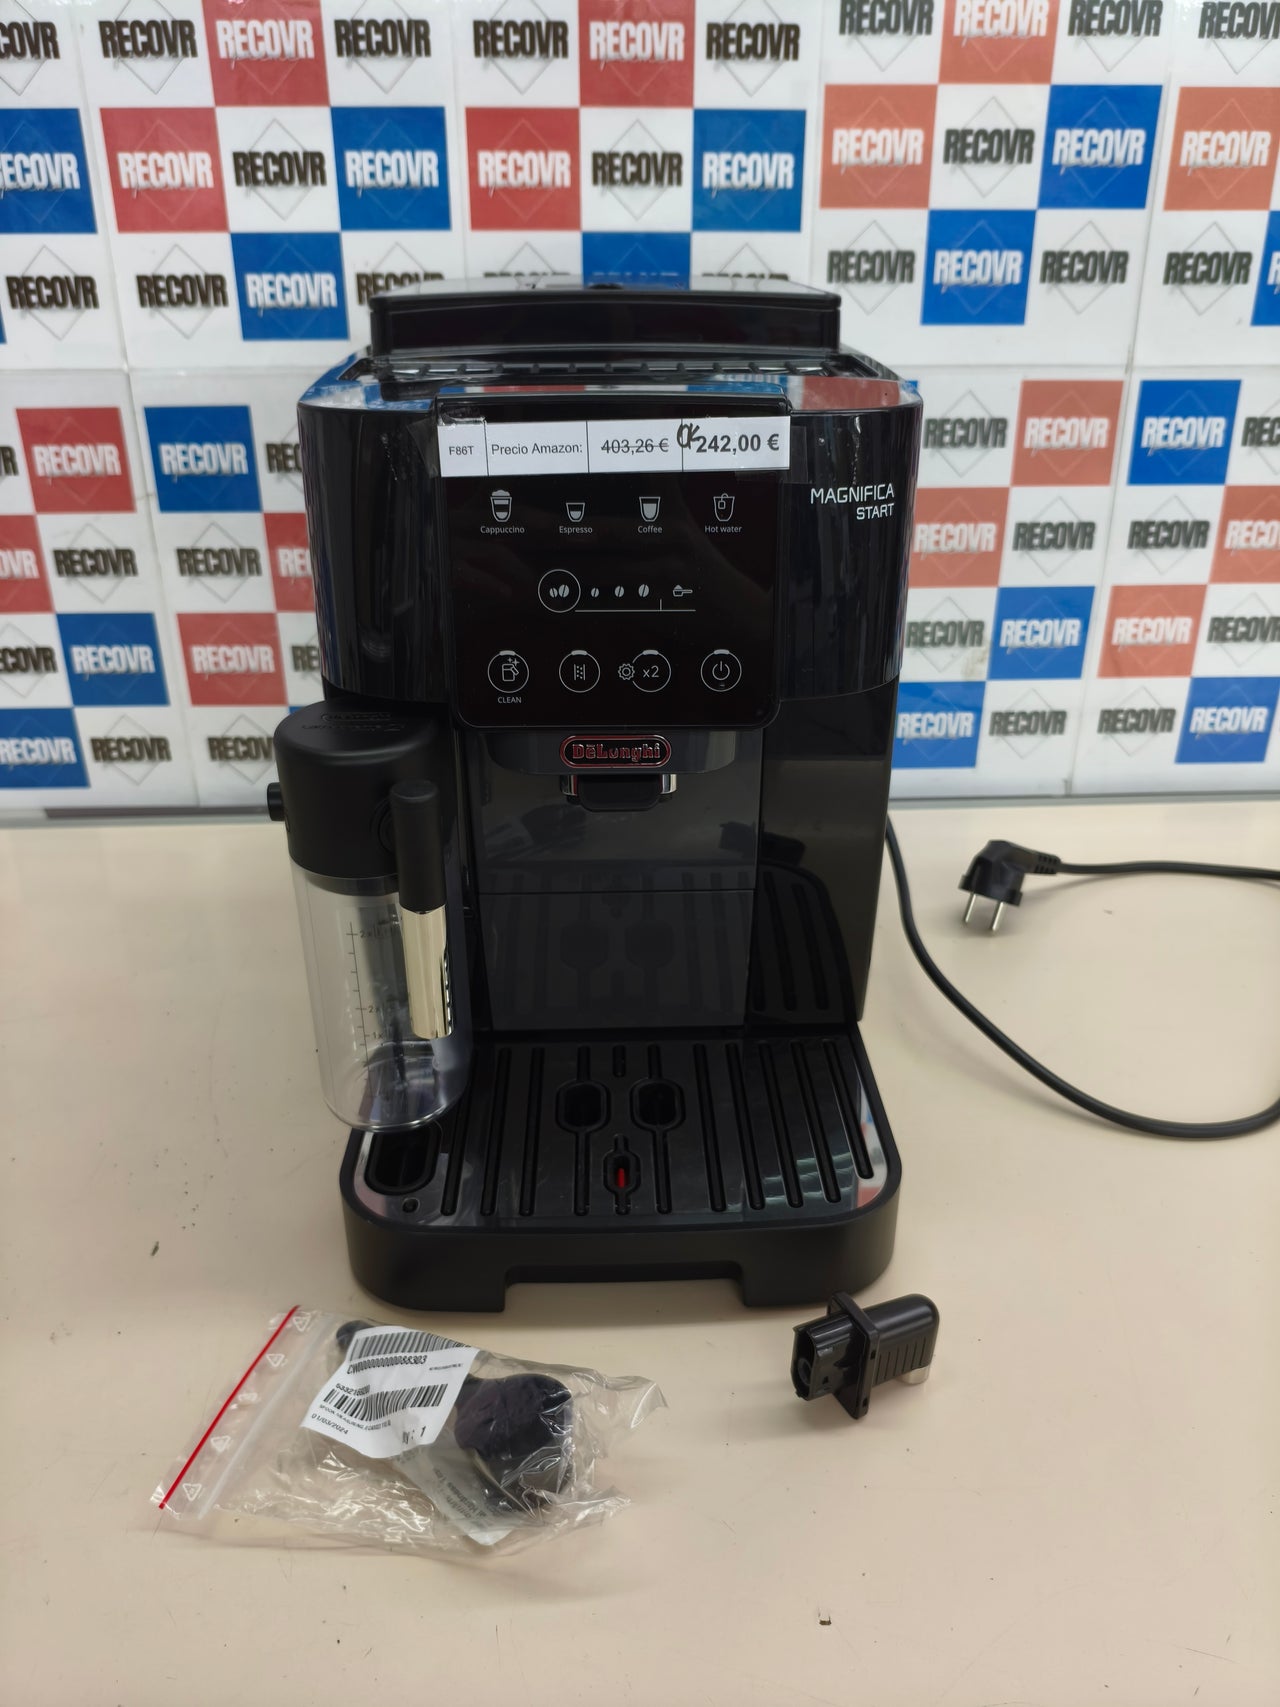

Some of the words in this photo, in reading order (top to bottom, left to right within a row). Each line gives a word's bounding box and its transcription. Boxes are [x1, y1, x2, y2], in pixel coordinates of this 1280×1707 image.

[839, 0, 933, 35] RECOVR
[953, 0, 1048, 37] RECOVR
[1068, 0, 1162, 36] RECOVR
[1198, 2, 1280, 39] RECOV
[100, 19, 197, 58] RECOVR
[216, 19, 314, 59] RECOVR
[334, 19, 431, 57] RECOVR
[472, 20, 569, 59] RECOVR
[590, 21, 684, 61] RECOVR
[706, 22, 800, 61] RECOVR
[832, 129, 924, 165] RECOVR
[943, 129, 1035, 164] RECOVR
[1052, 128, 1146, 165] RECOVR
[1180, 130, 1271, 166] RECOVR
[117, 151, 213, 188] RECOVR
[233, 151, 327, 187] RECOVR
[345, 151, 439, 188] RECOVR
[477, 152, 571, 189] RECOVR
[592, 151, 682, 187] RECOVR
[702, 153, 794, 190] RECOVR
[827, 250, 915, 284] RECOVR
[933, 249, 1022, 285] RECOVR
[1040, 250, 1128, 284] RECOVR
[1163, 251, 1252, 285] RECOVR
[7, 275, 98, 308] RECOVR
[137, 274, 228, 306] RECOVR
[246, 272, 337, 307] RECOVR
[601, 438, 654, 455] 403,26
[658, 438, 669, 452] €
[696, 434, 761, 455] 242,00
[767, 434, 780, 451] €
[923, 418, 1008, 449] RECOVR
[1023, 417, 1108, 448] RECOVR
[1141, 417, 1226, 447] RECOVR
[33, 445, 122, 476] RECOVR
[159, 443, 248, 475] RECOVR
[449, 446, 474, 456] F86T
[491, 444, 530, 455] Precio
[531, 443, 583, 455] Amazon:
[810, 483, 895, 505] MAGNIFICA
[855, 502, 895, 521] START
[480, 525, 525, 536] Cappuccino
[559, 525, 593, 536] Espresso
[637, 524, 663, 534] Coffee
[704, 525, 718, 534] Hot
[720, 526, 742, 534] water
[913, 523, 996, 552] RECOVR
[1012, 522, 1096, 550] RECOVR
[1128, 521, 1210, 549] RECOVR
[53, 549, 138, 577] RECOVR
[177, 548, 262, 576] RECOVR
[905, 621, 985, 648] RECOVR
[1000, 620, 1081, 648] RECOVR
[1111, 618, 1192, 645] RECOVR
[71, 645, 156, 674] RECOVR
[190, 646, 275, 673] RECOVR
[642, 665, 659, 678] x2
[497, 696, 522, 704] CLEAN
[897, 713, 975, 738] RECOVR
[989, 711, 1067, 735] RECOVR
[1098, 709, 1176, 734] RECOVR
[1189, 707, 1268, 734] RECOVR
[0, 737, 76, 763] RECOVR
[91, 737, 172, 762] RECOVR
[311, 1413, 349, 1435] 01/03/2024
